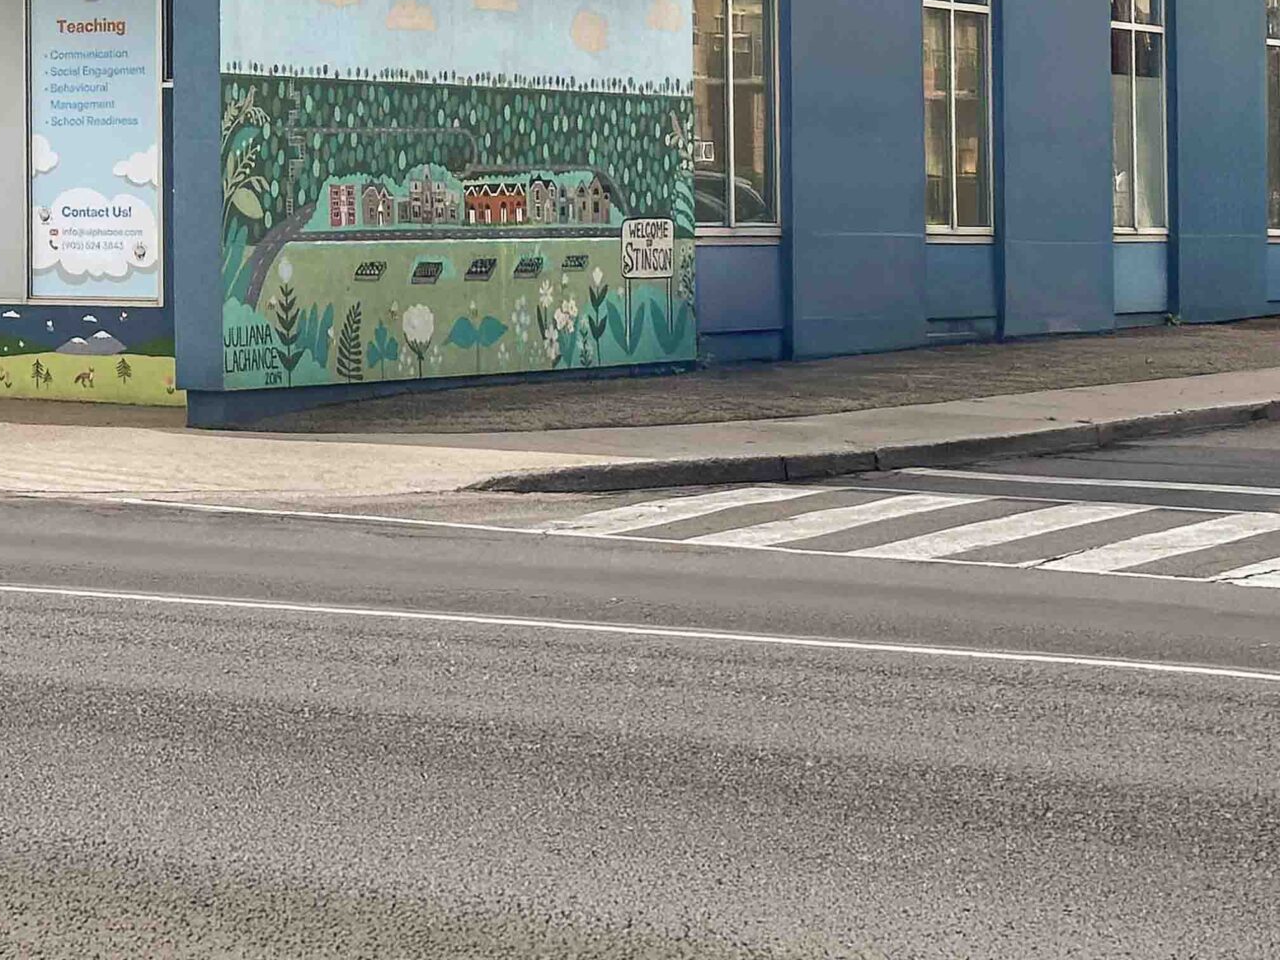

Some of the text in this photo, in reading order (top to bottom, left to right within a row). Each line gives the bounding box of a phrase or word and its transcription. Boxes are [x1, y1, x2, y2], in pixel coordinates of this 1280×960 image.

[56, 18, 126, 36] Teaching
[50, 48, 128, 60] Communication
[50, 65, 146, 78] Social Engagement
[50, 82, 108, 93] Behavioural
[50, 100, 115, 112] Management
[50, 115, 139, 127] School Readiness
[62, 206, 132, 218] Contact Us!
[629, 221, 669, 239] WELCOME
[623, 242, 672, 274] STINSON
[224, 324, 273, 347] JULIANA
[225, 347, 279, 373] LACHANCE
